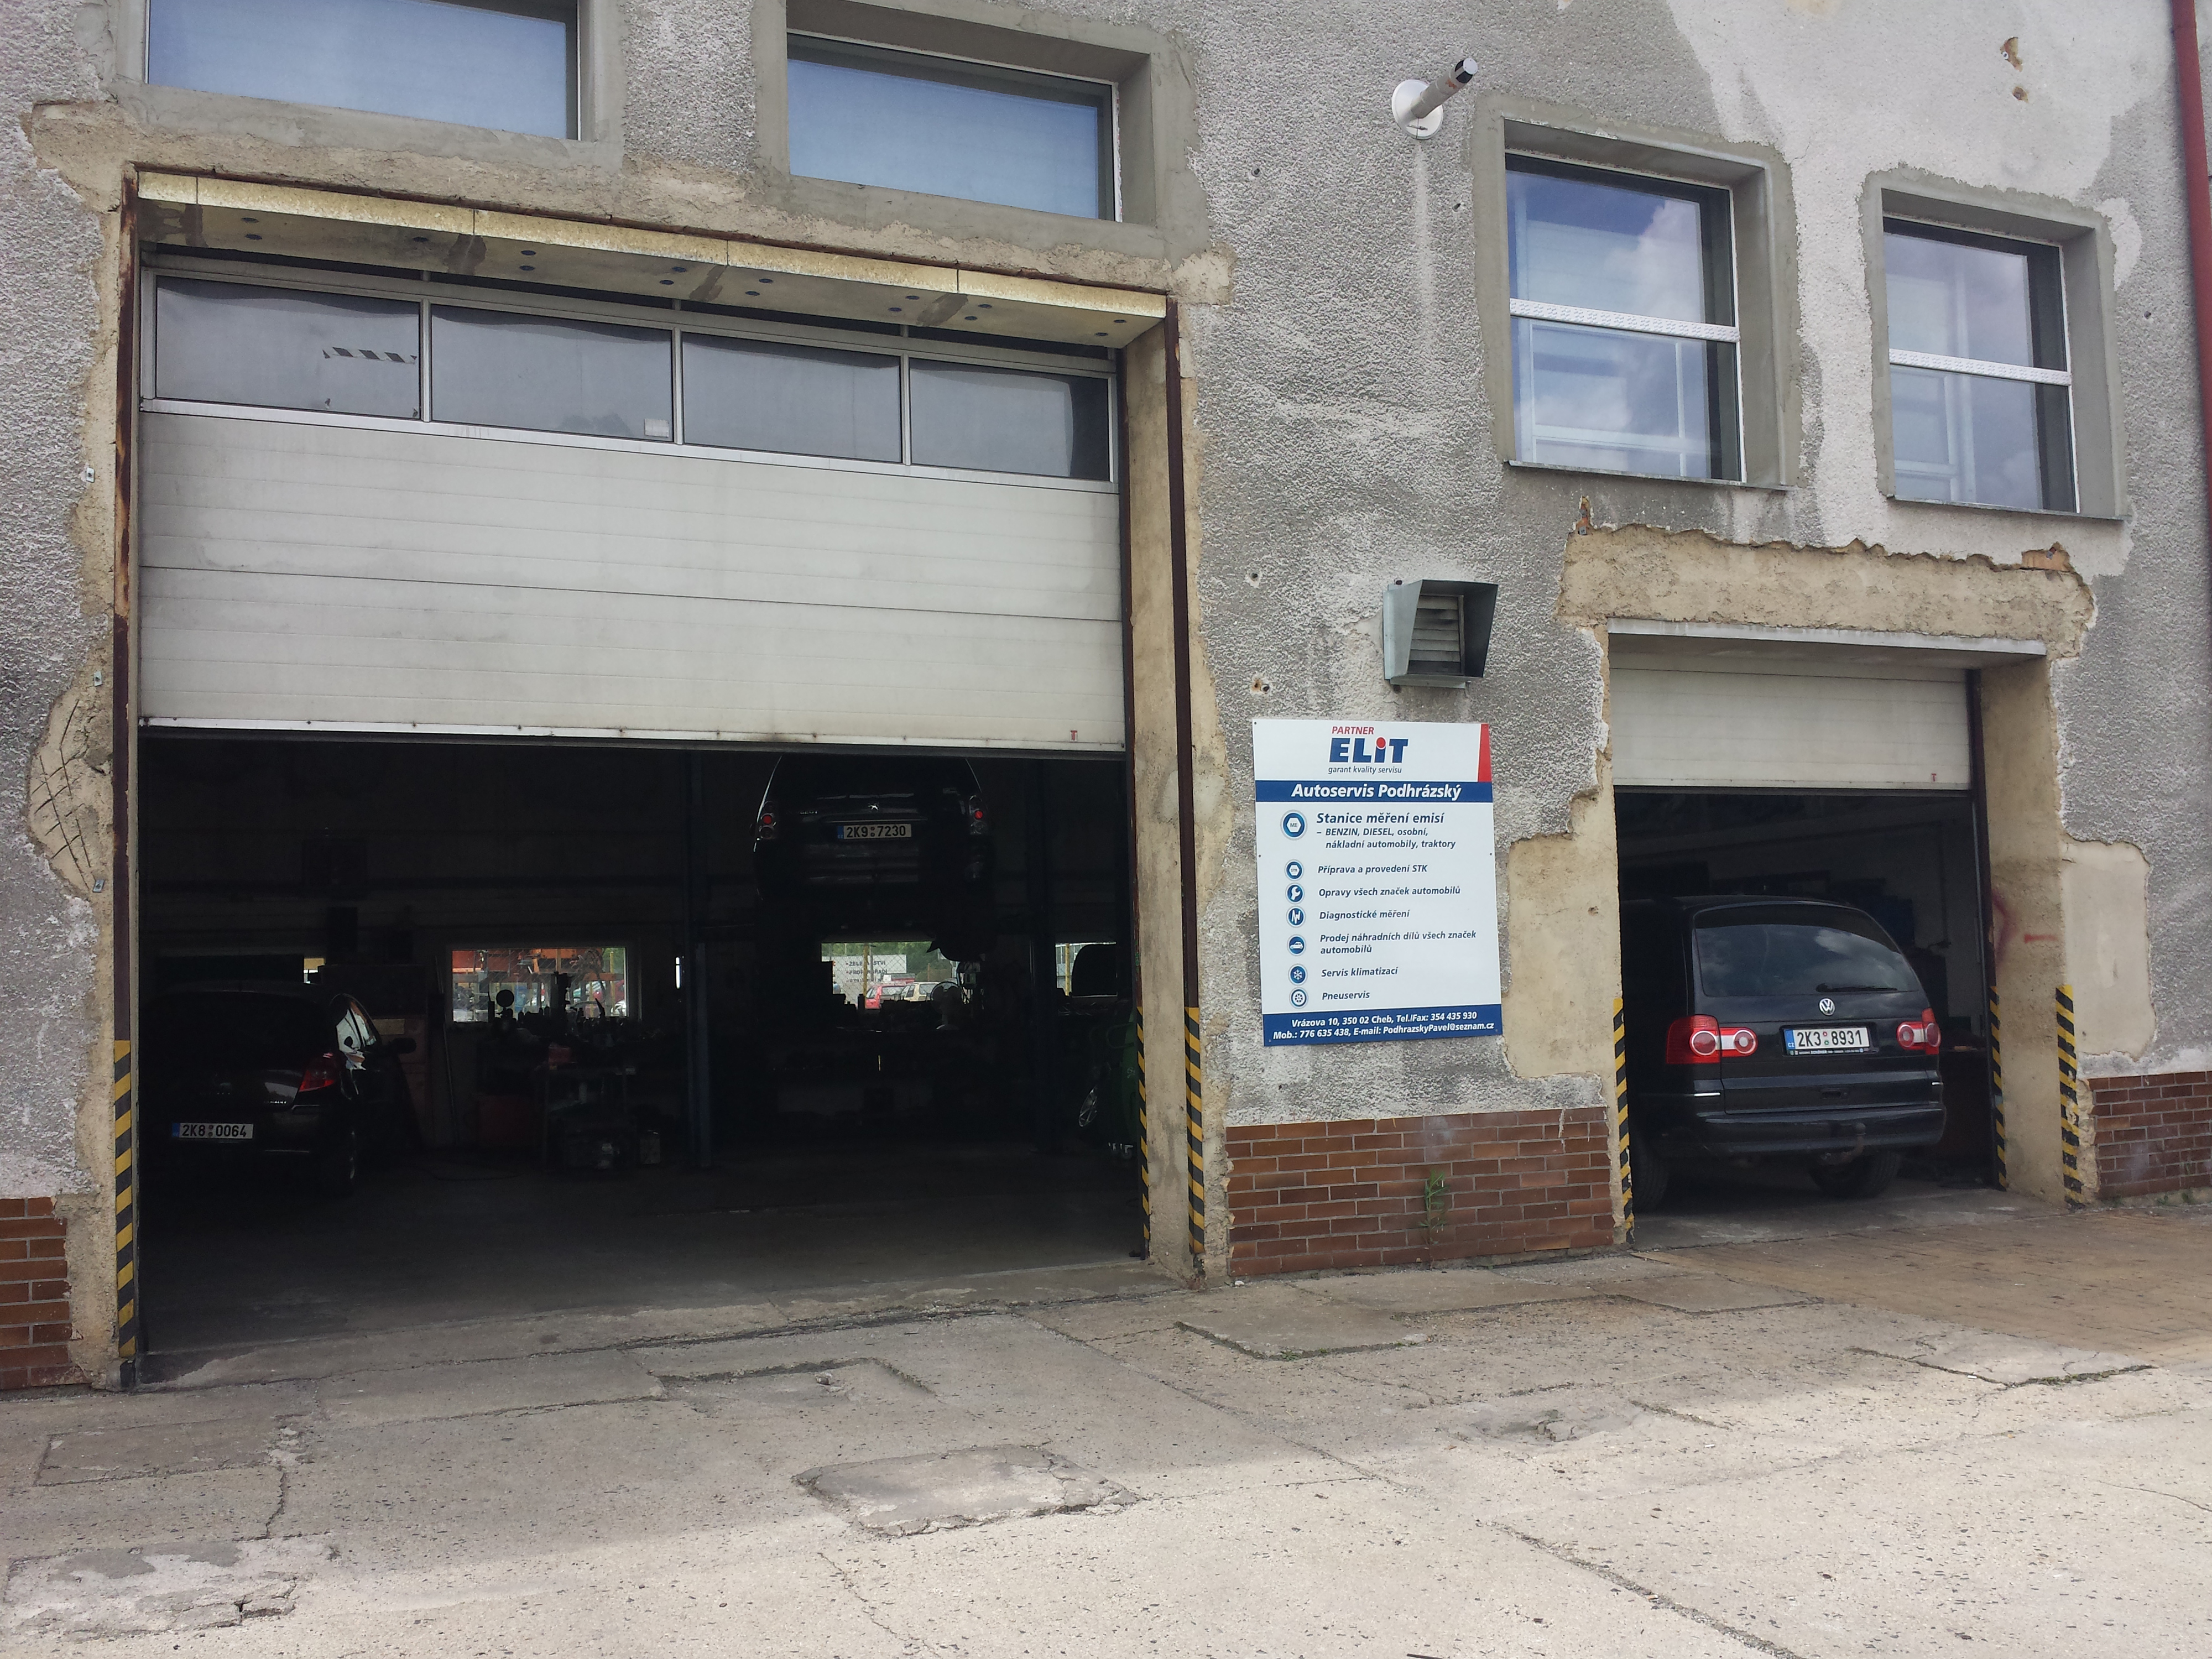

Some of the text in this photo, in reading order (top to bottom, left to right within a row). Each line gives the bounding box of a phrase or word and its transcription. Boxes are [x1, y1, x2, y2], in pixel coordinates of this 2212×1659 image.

[1332, 726, 1374, 735] PARTNER
[1328, 766, 1352, 775] garant
[1353, 765, 1377, 775] kvality
[1291, 783, 1462, 801] Autoservis Podhrázský
[1316, 812, 1445, 823] Stanice měření emisí
[846, 825, 906, 838] 2K9 7230
[1325, 828, 1360, 837] BENZIN,
[1363, 828, 1394, 837] DIESEL,
[1397, 827, 1428, 837] osobní,
[1326, 839, 1456, 850] nákladní automobily, traktory
[1318, 865, 1355, 875] Příprava
[1365, 864, 1410, 875] provedení
[1412, 864, 1428, 873] STK
[1319, 885, 1460, 899] Opravy všech značek automobilů
[1319, 909, 1410, 921] Diagnostické měření
[1320, 930, 1477, 944] Prodej náhradních dílů všech značek
[1320, 944, 1372, 954] automobilů
[1321, 966, 1399, 977] Servis klimatizací
[1322, 990, 1370, 1000] Pneuservis
[1291, 1019, 1326, 1027] Vrázova
[1328, 1018, 1340, 1026] 10,
[1342, 1016, 1358, 1025] 350
[1359, 1016, 1369, 1024] 02
[1371, 1014, 1394, 1024] Cheb,
[1430, 1013, 1445, 1021] 354
[1446, 1012, 1462, 1020] 435
[1462, 1011, 1477, 1020] 930
[1273, 1030, 1298, 1040] Mob.:
[1300, 1030, 1315, 1038] 776
[1317, 1029, 1333, 1037] 635
[1333, 1028, 1351, 1037] 438,
[1353, 1026, 1381, 1035] E-mail:
[1797, 1030, 1863, 1047] 2K3 8931
[182, 1124, 206, 1136] 2K8
[216, 1124, 247, 1137] 0064
